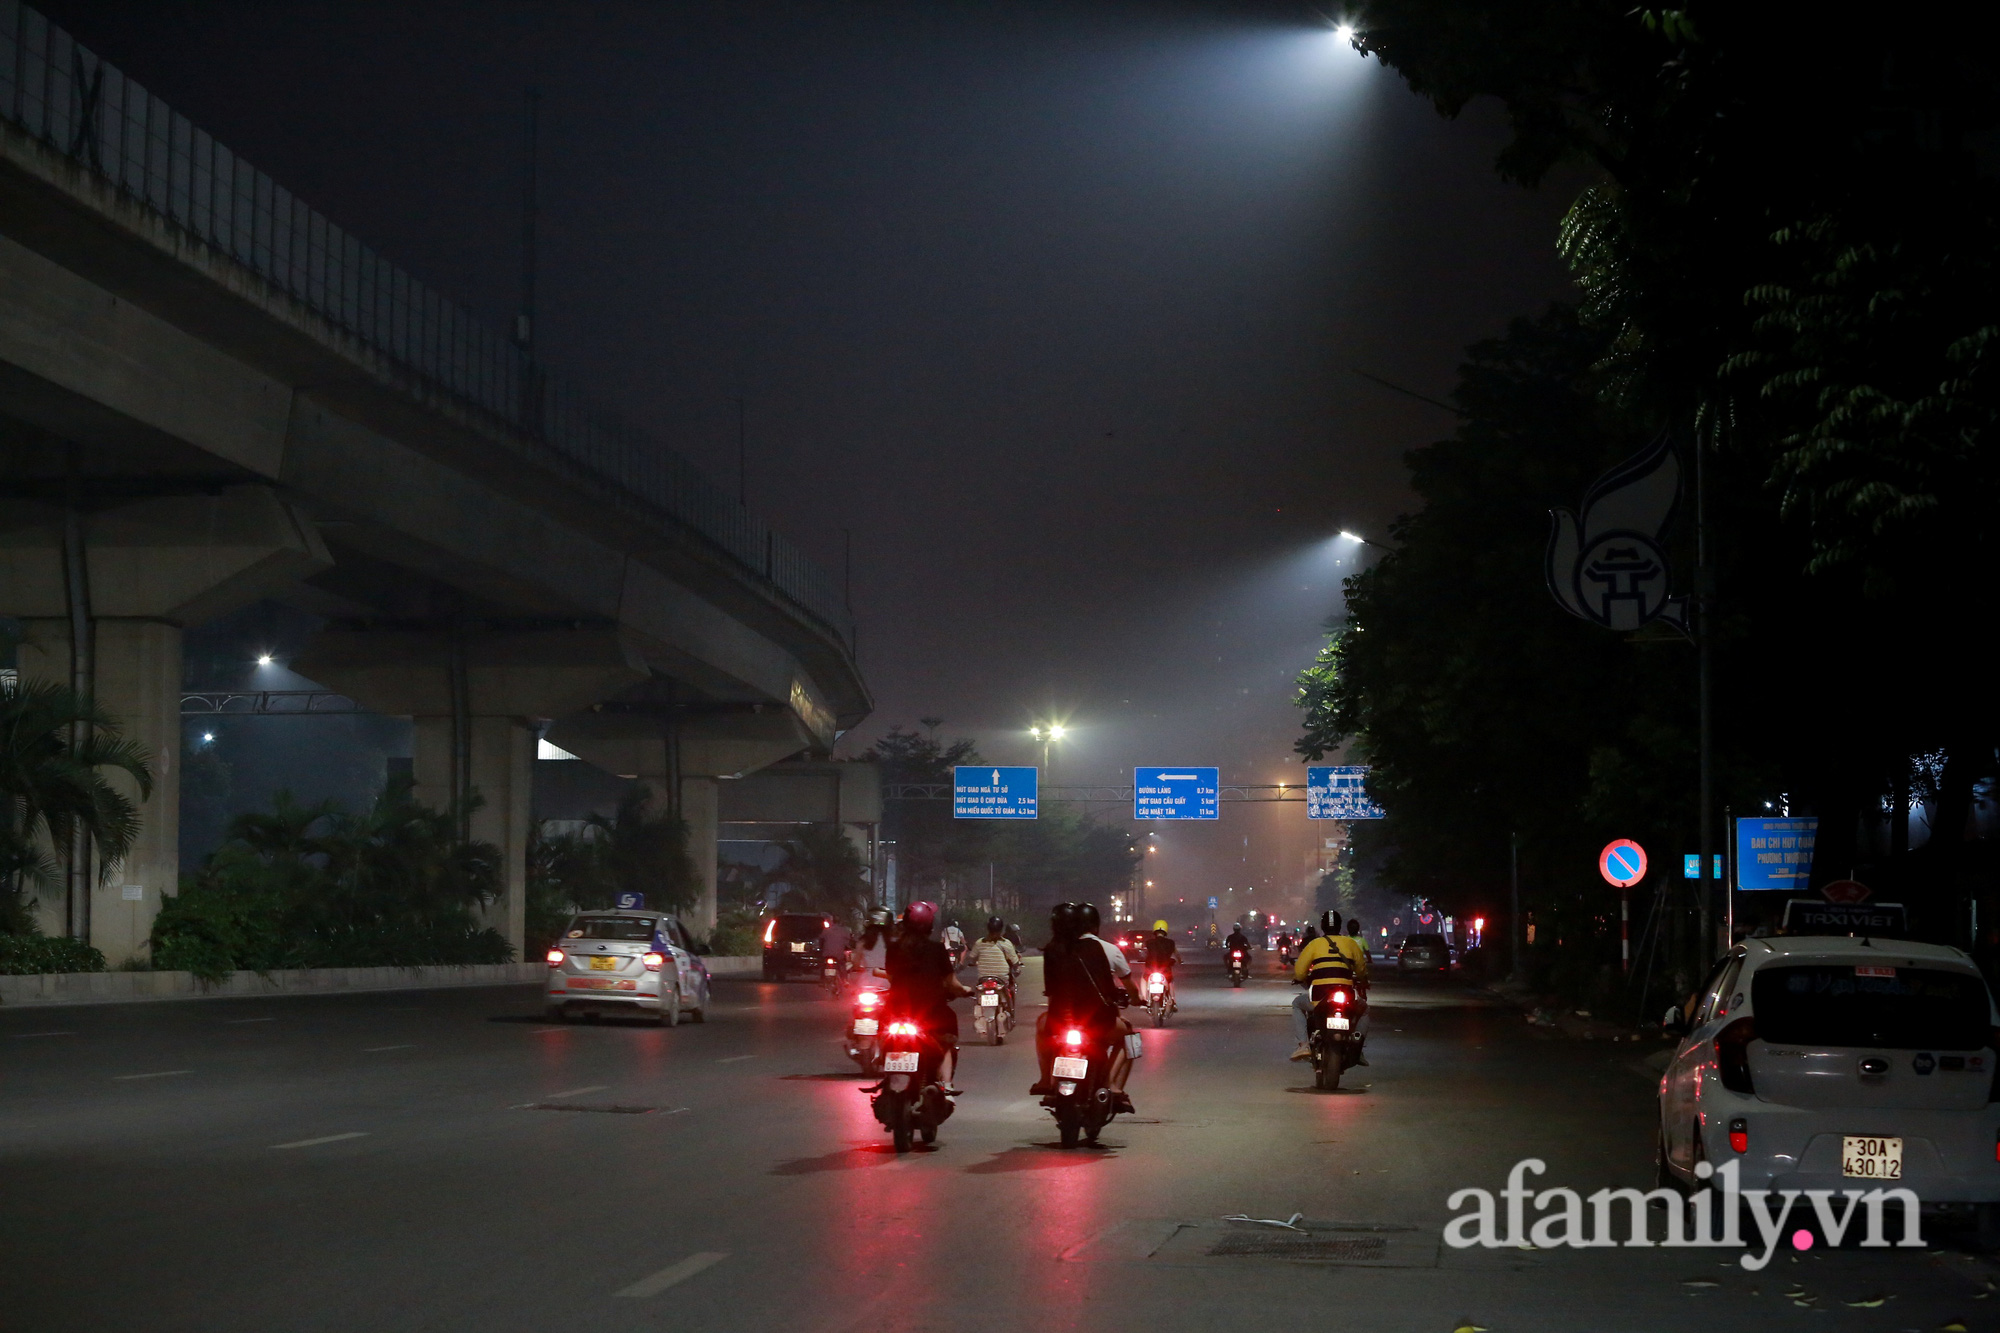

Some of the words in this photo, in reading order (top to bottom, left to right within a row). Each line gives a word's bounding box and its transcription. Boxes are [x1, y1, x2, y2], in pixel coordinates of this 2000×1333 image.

[1751, 838, 1766, 849] BAN
[1782, 837, 1796, 848] HUY
[1857, 1139, 1887, 1156] 30A
[1844, 1158, 1899, 1177] 430.12
